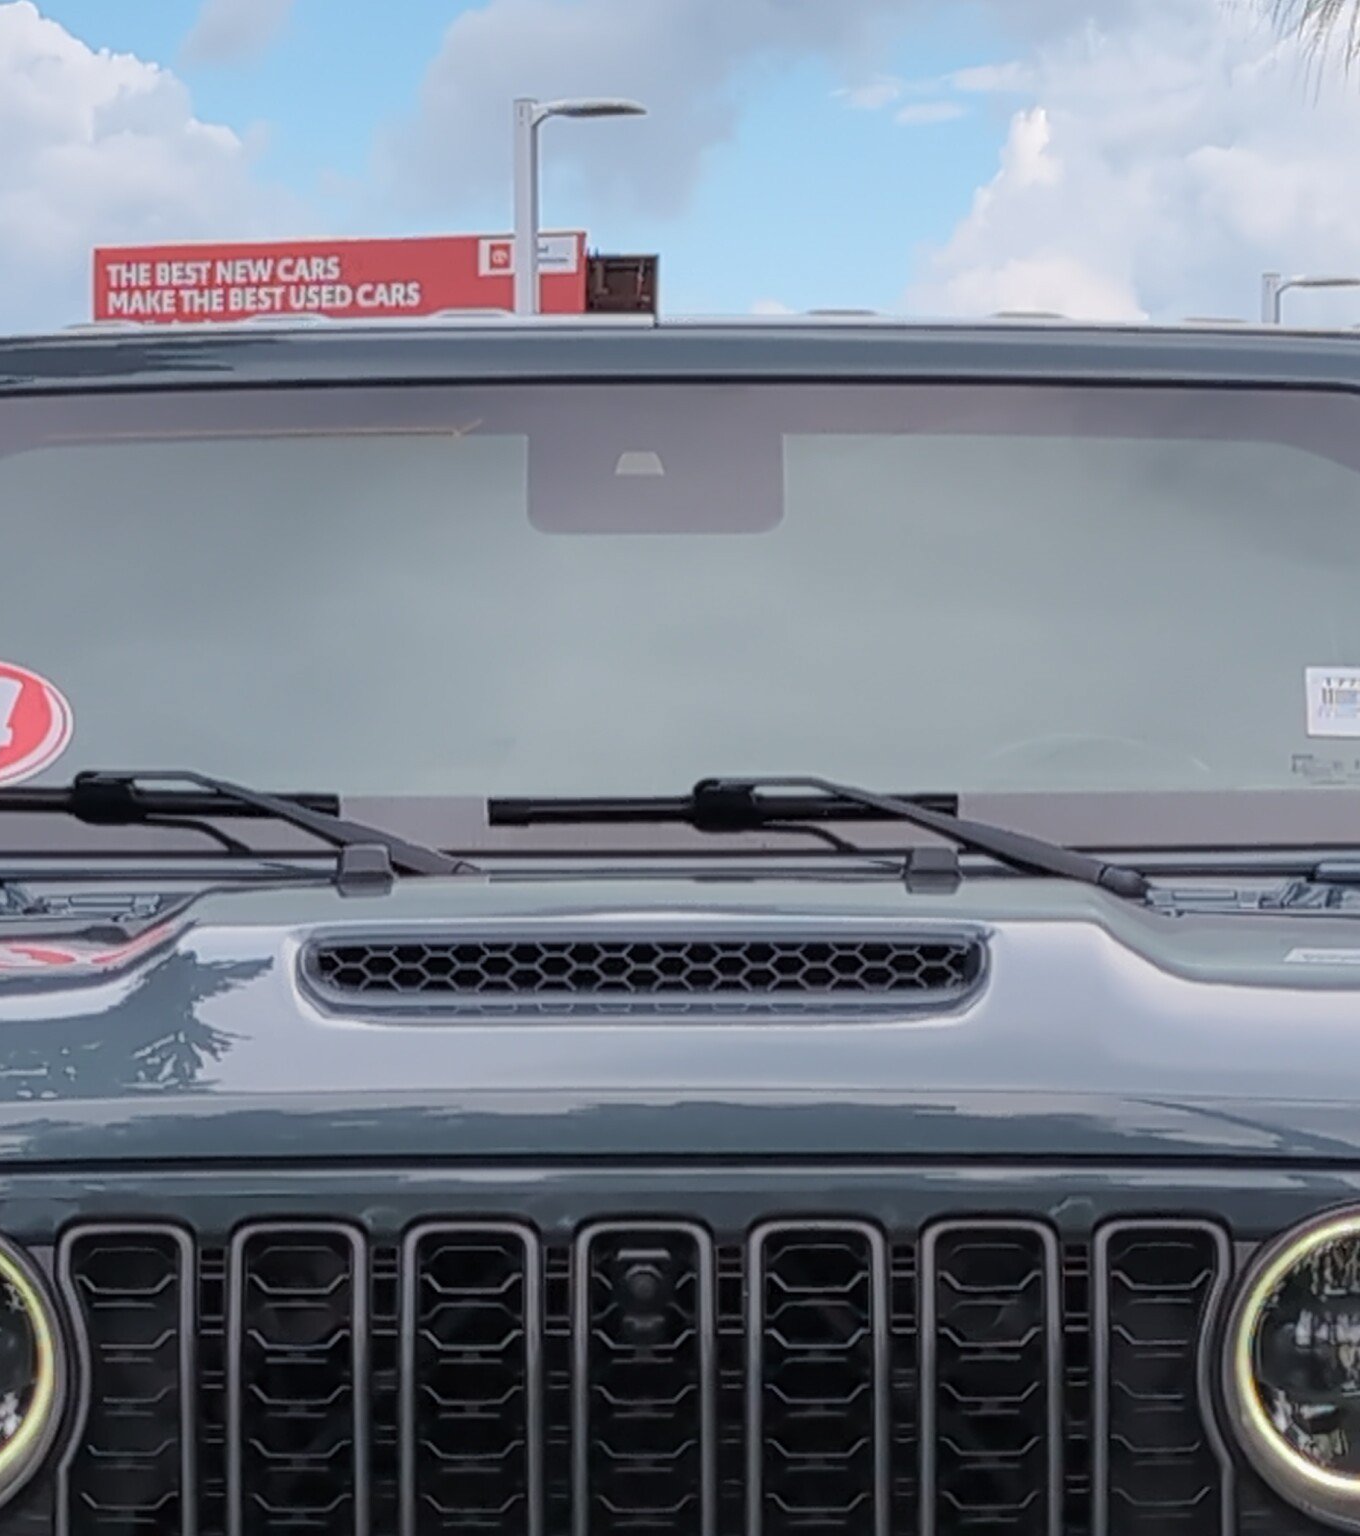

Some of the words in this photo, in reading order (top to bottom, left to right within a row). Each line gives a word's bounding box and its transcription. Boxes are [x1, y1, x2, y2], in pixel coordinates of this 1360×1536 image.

[106, 263, 151, 288] THE
[155, 260, 211, 287] BEST
[216, 258, 274, 285] NEW
[277, 256, 340, 283] CARS
[107, 289, 176, 315] MAKE
[179, 288, 224, 313] THE
[228, 285, 285, 312] BEST
[291, 284, 353, 310] USED
[356, 281, 421, 307] CARS
